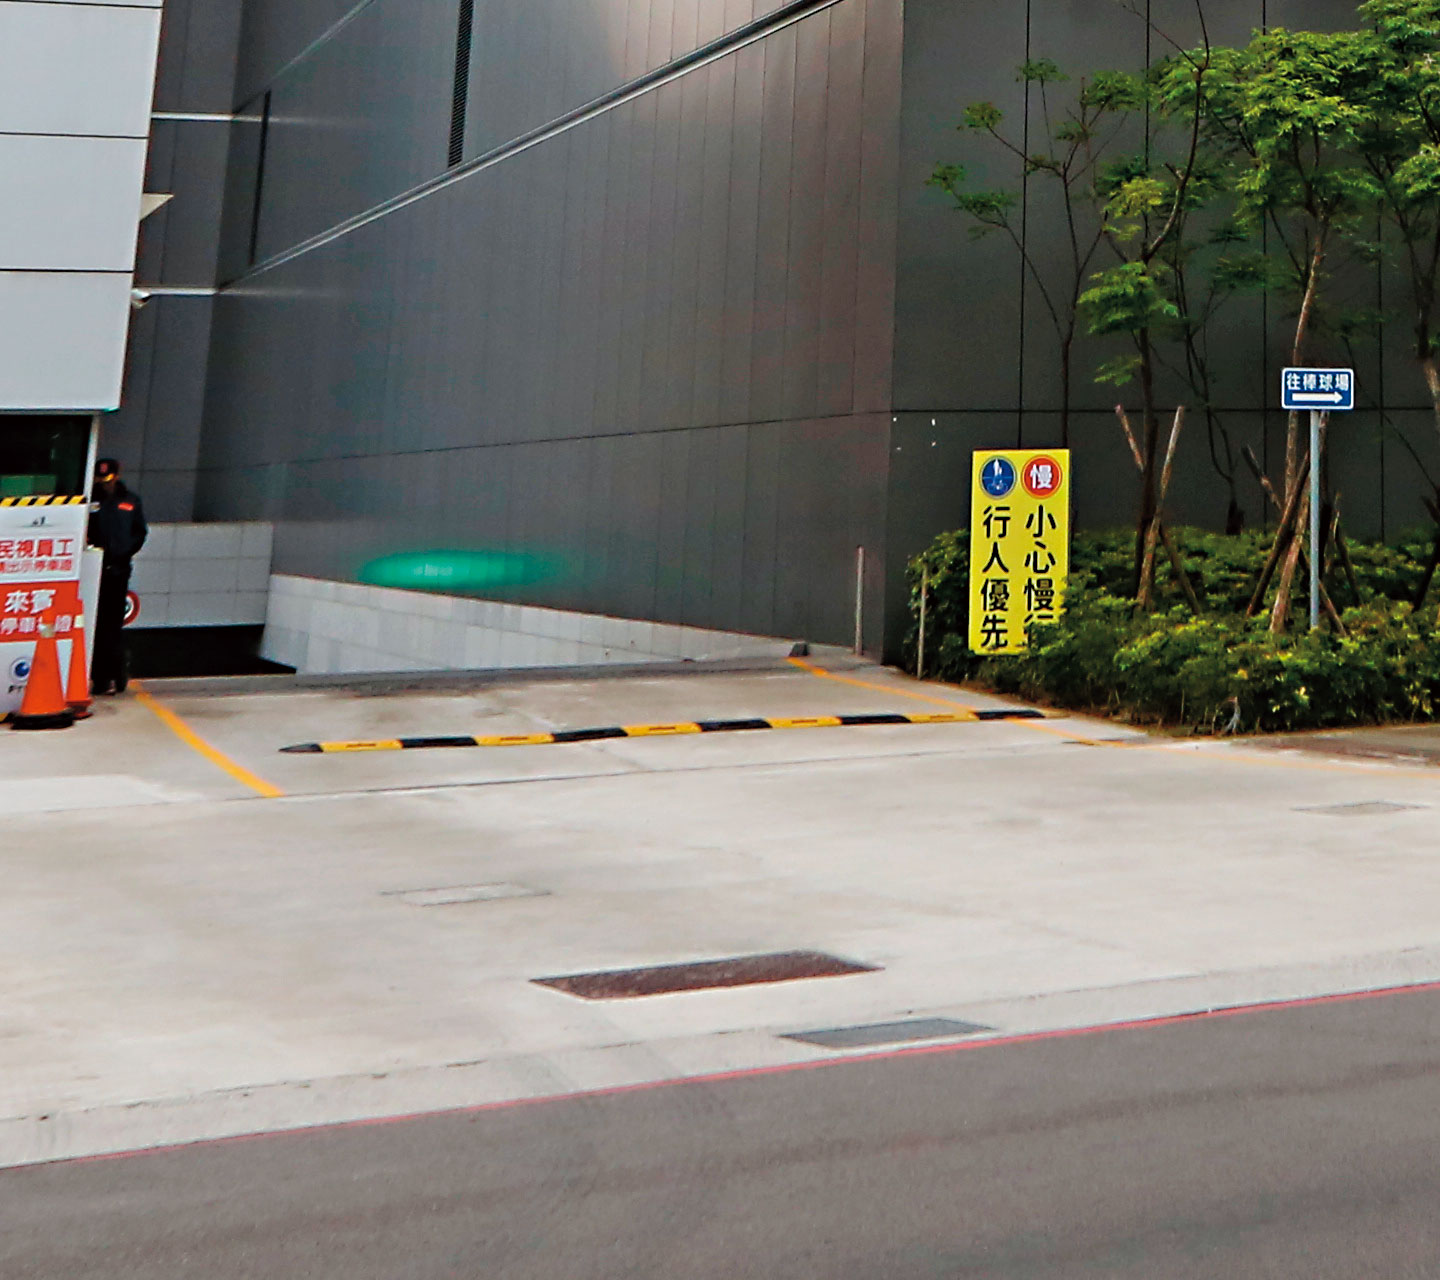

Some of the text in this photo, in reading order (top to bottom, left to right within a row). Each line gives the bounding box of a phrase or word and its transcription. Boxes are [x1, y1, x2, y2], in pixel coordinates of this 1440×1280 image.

[1286, 373, 1350, 391] 往棒球場
[980, 505, 1011, 648] 行人優先
[4, 589, 57, 614] 來賓
